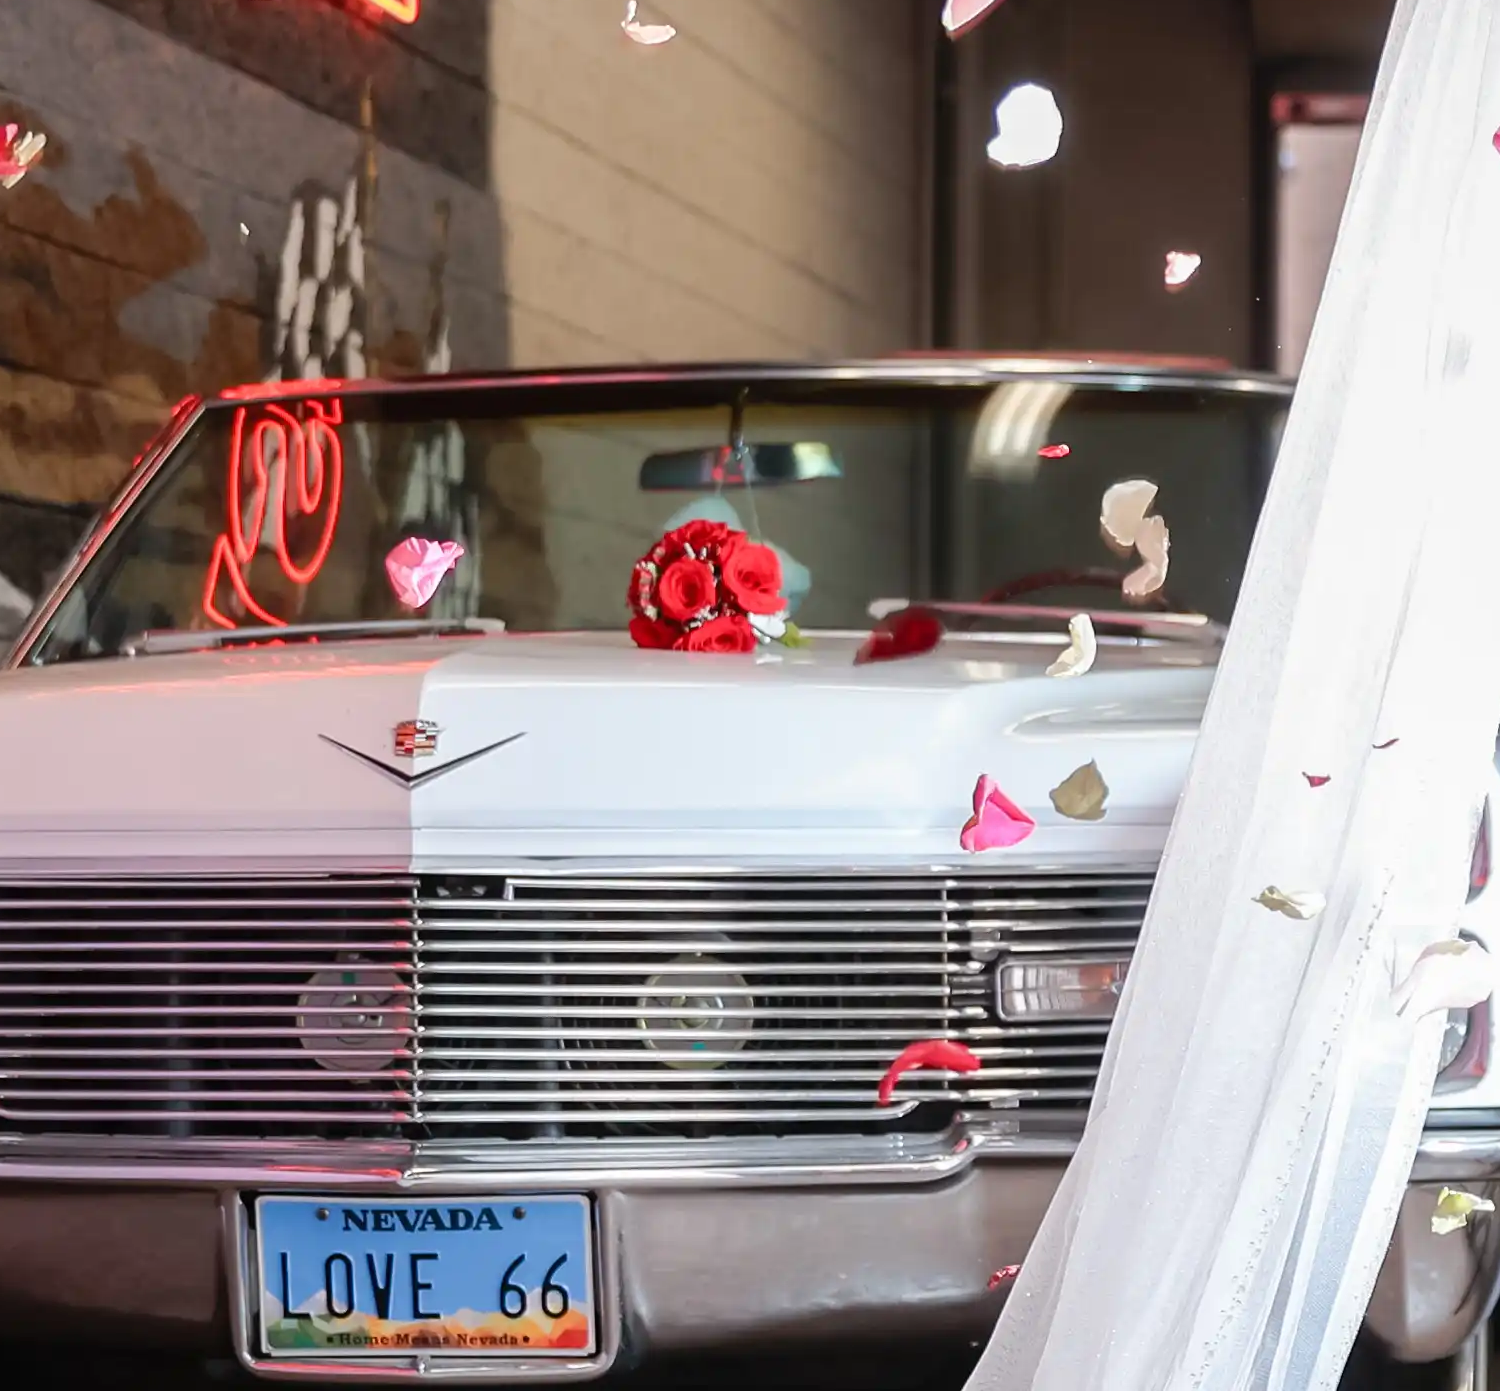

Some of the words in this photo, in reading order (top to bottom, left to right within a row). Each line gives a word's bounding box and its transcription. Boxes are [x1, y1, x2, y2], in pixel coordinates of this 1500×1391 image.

[342, 1207, 503, 1233] NEVADA
[280, 1251, 441, 1320] LOVE
[500, 1253, 570, 1320] 66
[339, 1333, 391, 1346] Home
[396, 1333, 450, 1346] Means
[457, 1333, 518, 1346] Nevada
